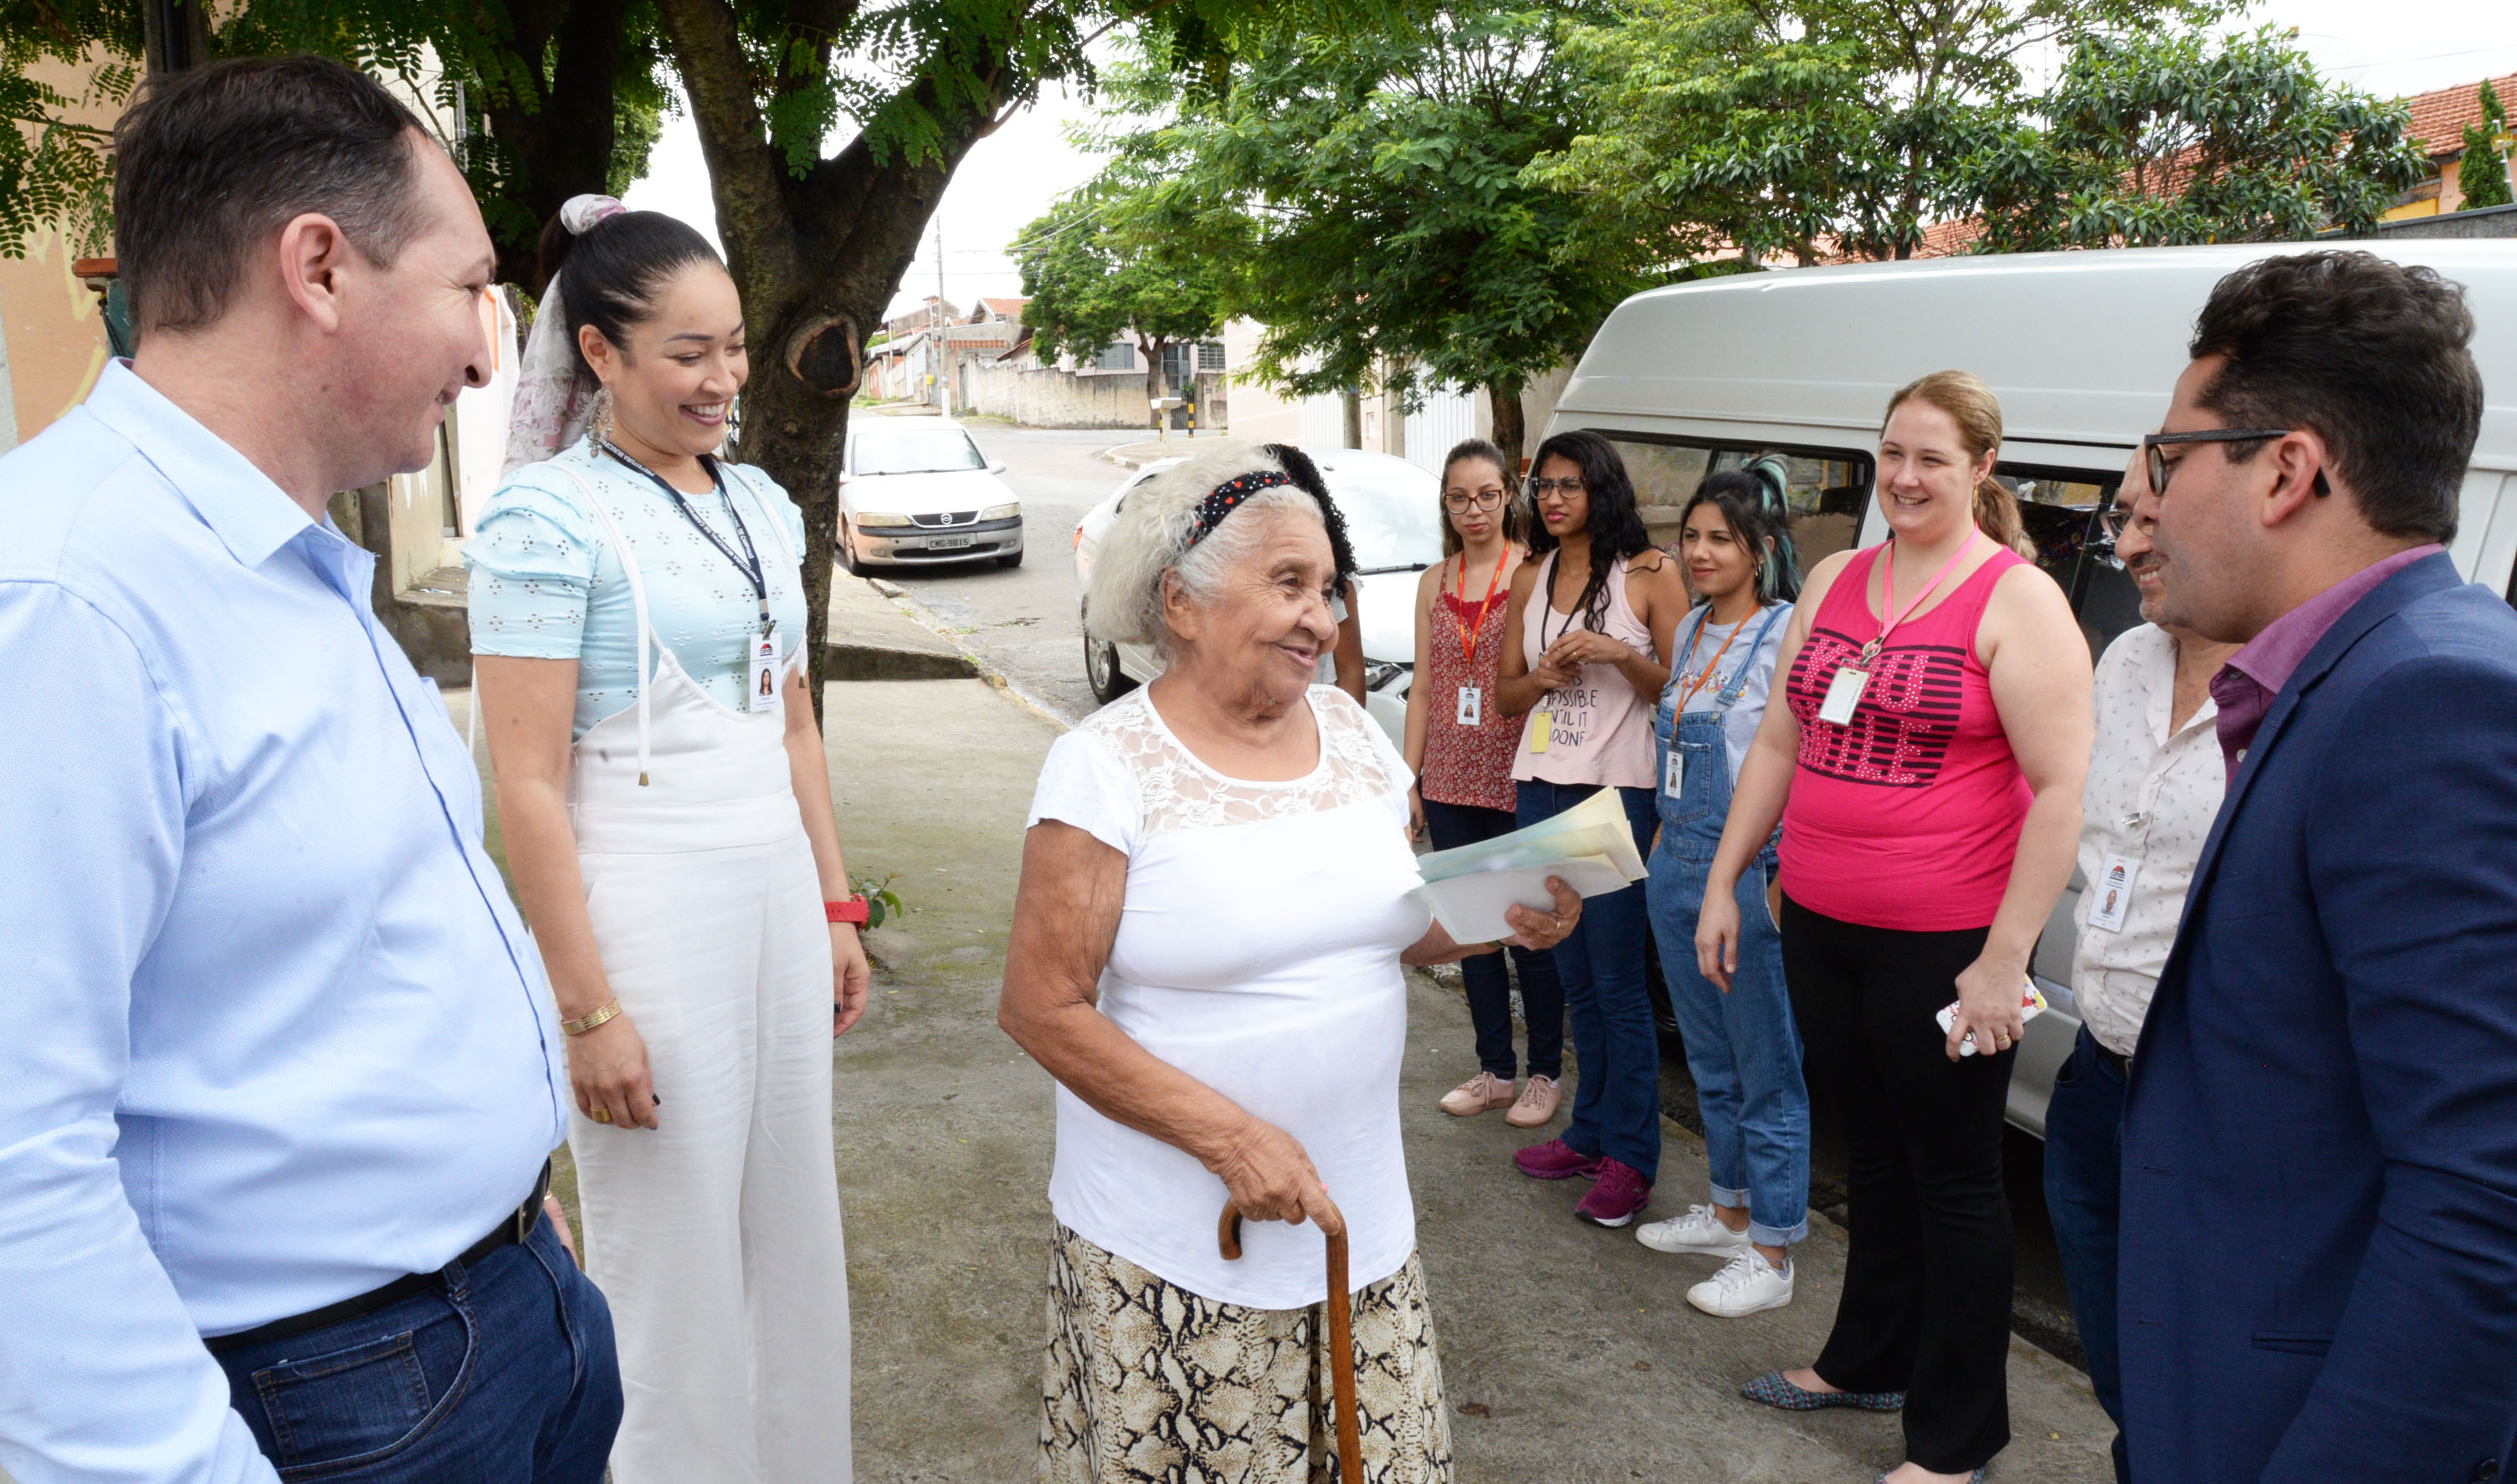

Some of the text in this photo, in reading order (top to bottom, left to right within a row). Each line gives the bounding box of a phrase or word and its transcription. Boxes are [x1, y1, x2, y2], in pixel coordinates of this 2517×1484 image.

[683, 501, 705, 527] CAMPINAS
[703, 525, 712, 534] DE
[710, 531, 735, 557] MUNICIPAL
[1579, 711, 1587, 727] IT
